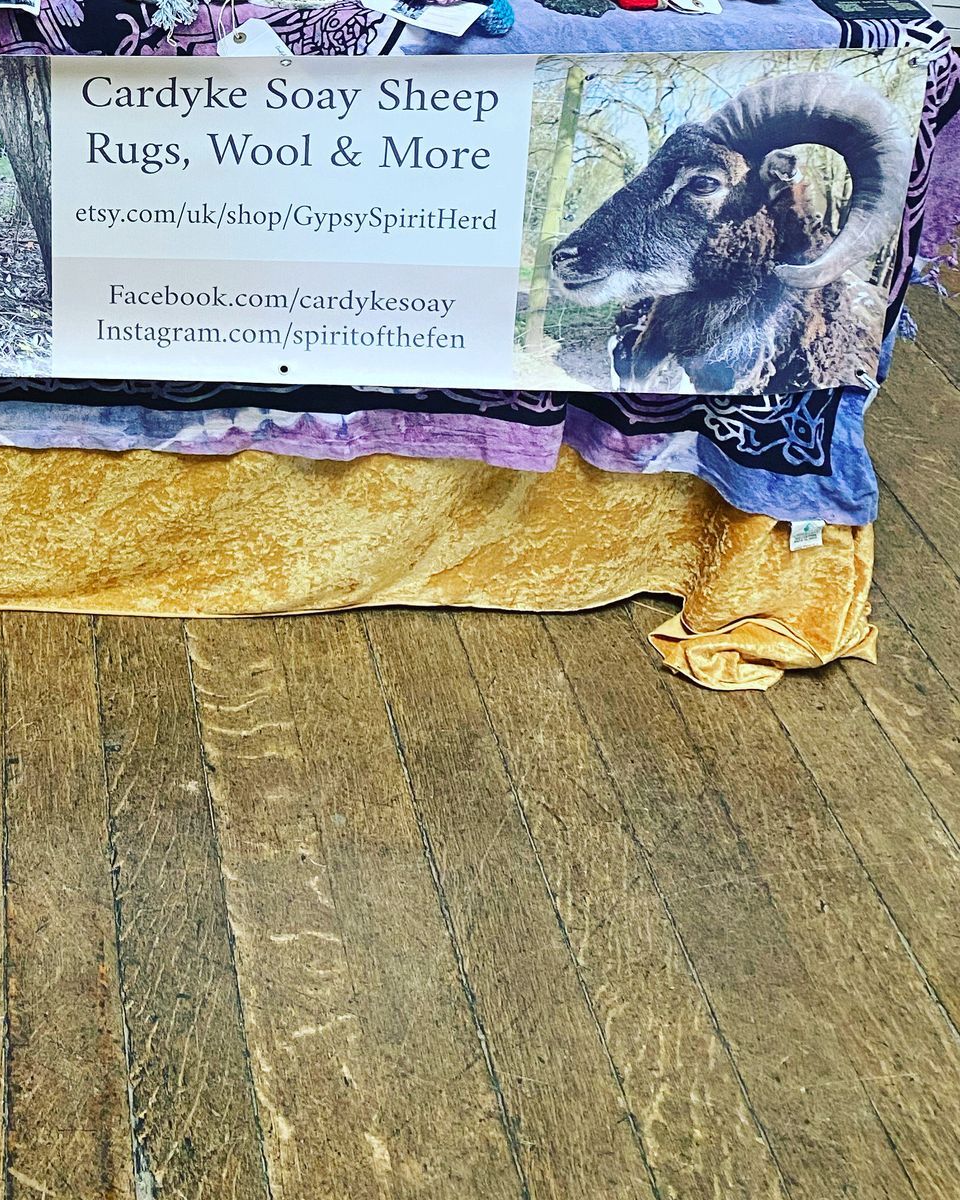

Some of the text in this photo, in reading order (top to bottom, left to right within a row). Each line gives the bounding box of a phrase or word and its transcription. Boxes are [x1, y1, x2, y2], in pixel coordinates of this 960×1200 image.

[82, 76, 498, 122] Cardyke Soay Sheep
[86, 132, 490, 174] Rugs, Wool & More
[75, 202, 497, 234] etsy.com/uk/shop/GypsySpiritHerd
[109, 285, 457, 318] Facebook.com/cardykesoay
[97, 319, 465, 352] Instagram.com/spiritofthefen
